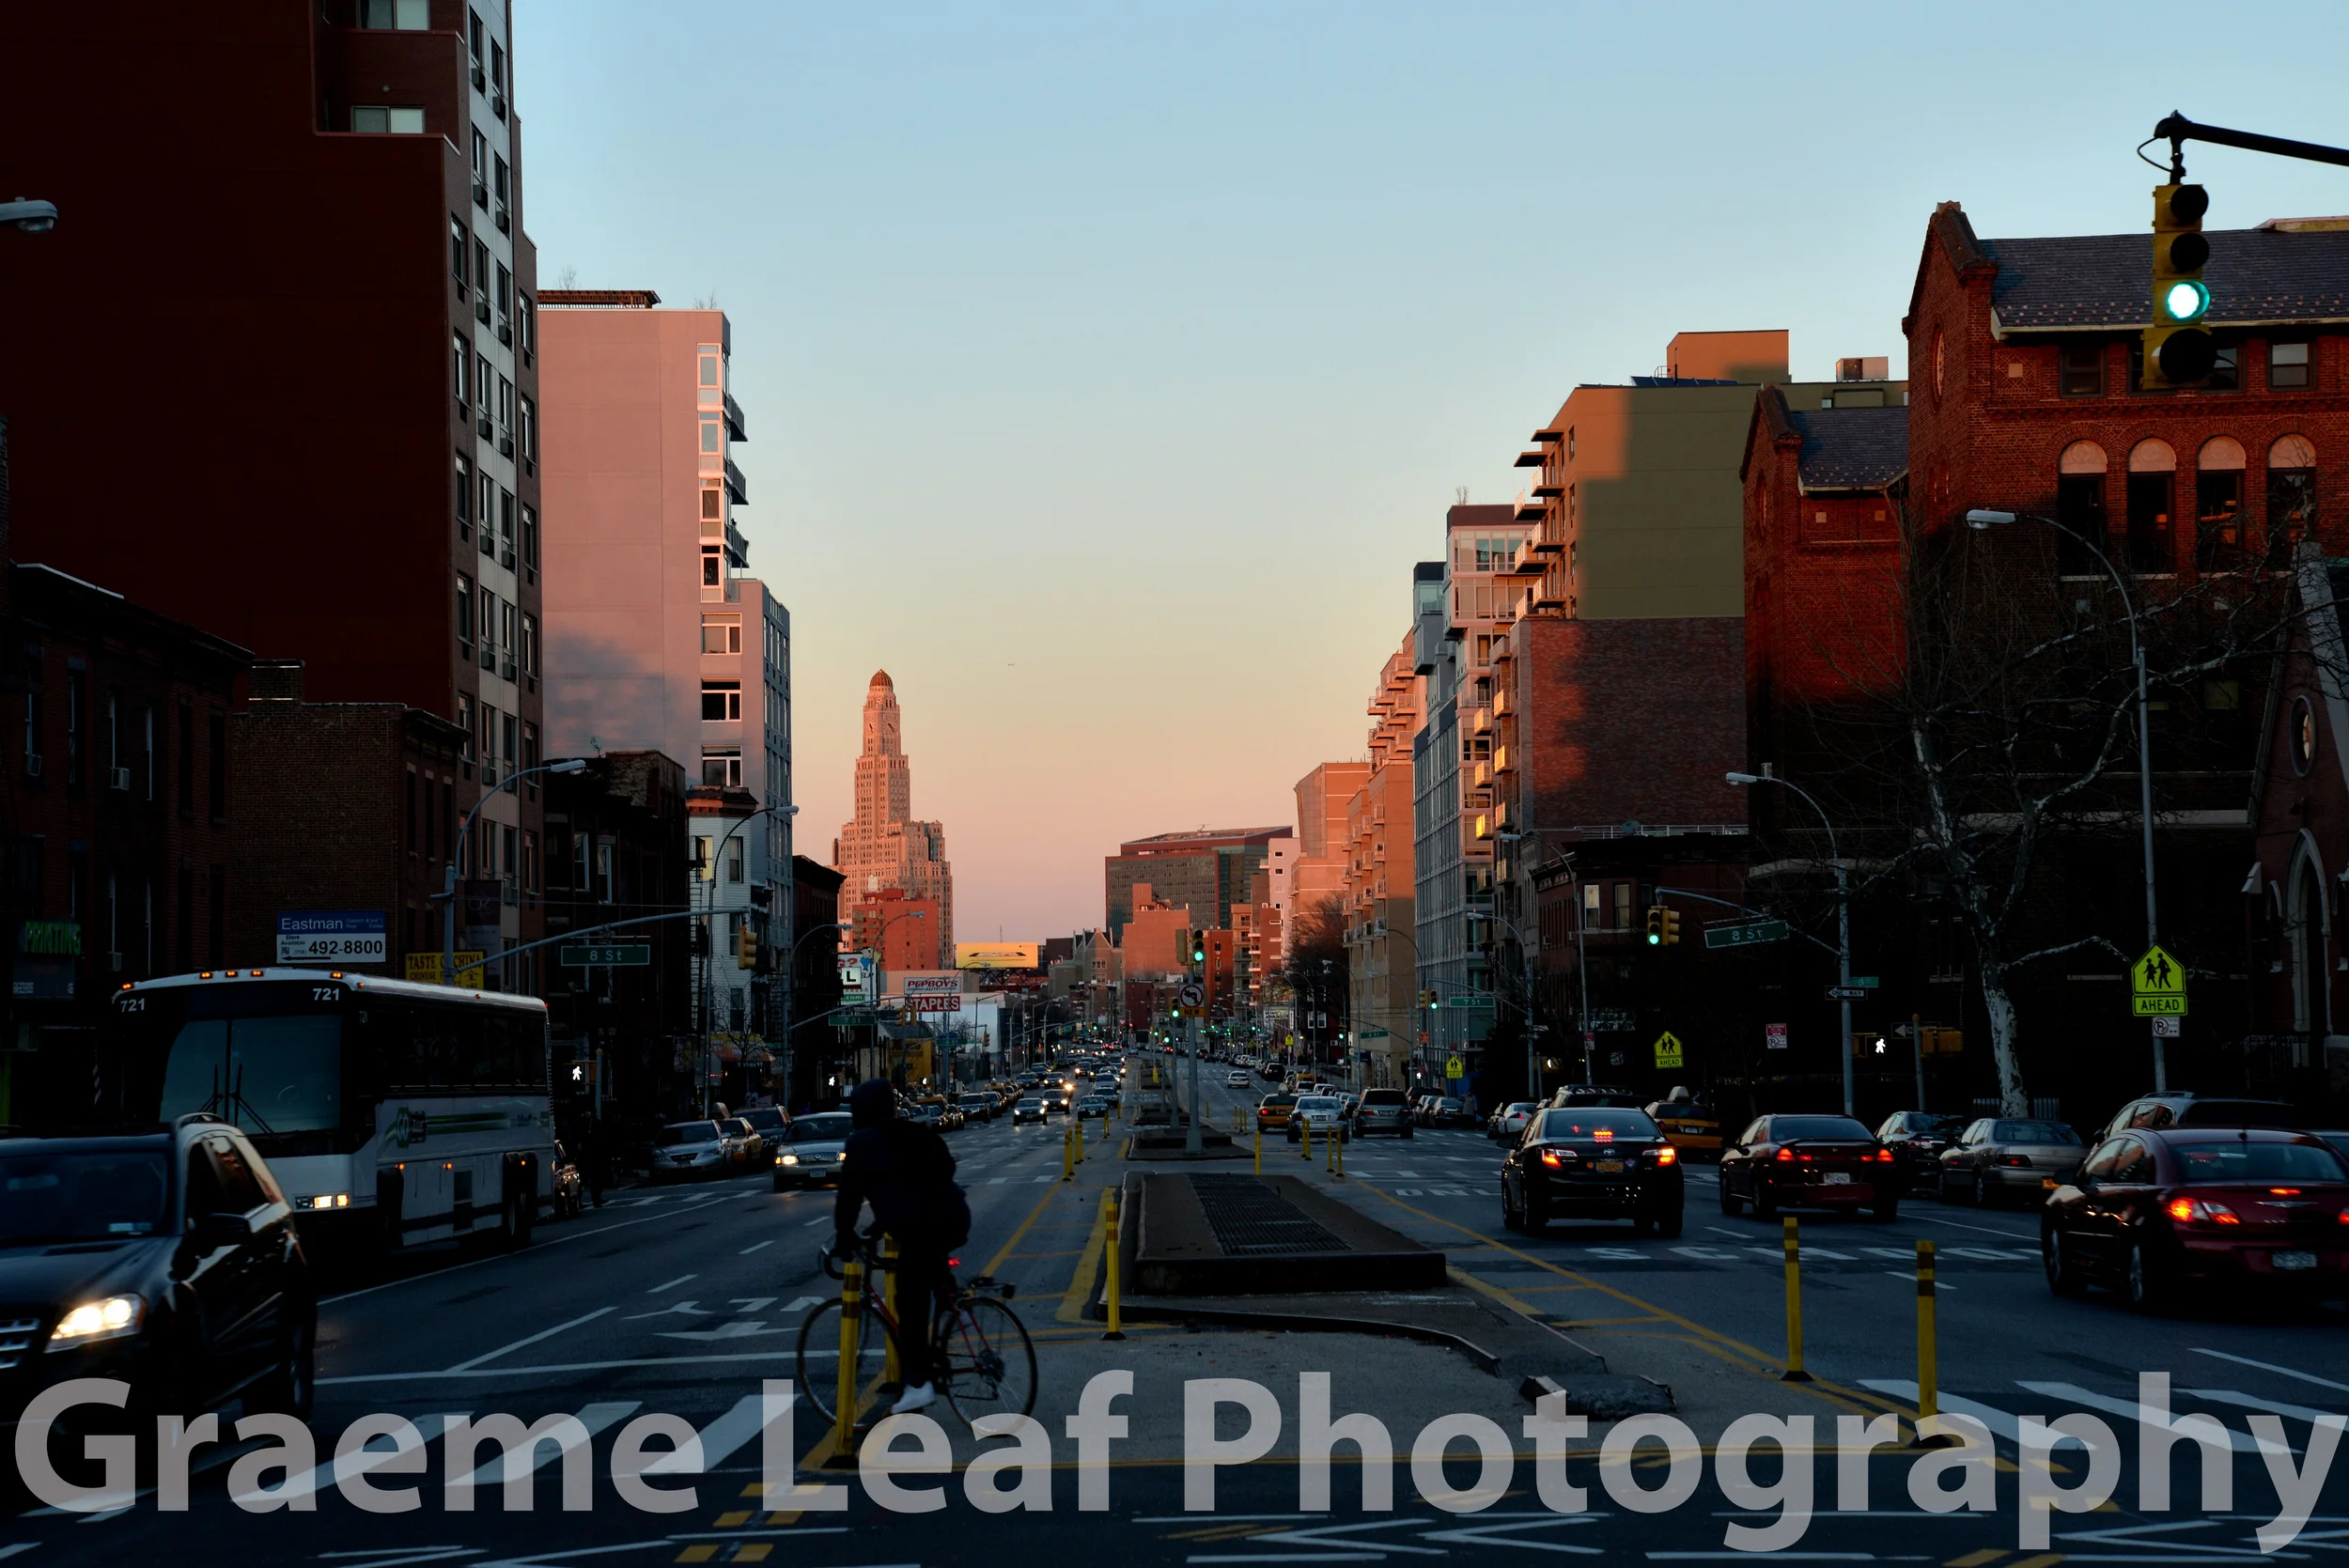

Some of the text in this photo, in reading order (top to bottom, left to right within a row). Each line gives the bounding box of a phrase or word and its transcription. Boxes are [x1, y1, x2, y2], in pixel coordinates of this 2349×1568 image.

[282, 918, 343, 930] Eastman
[24, 921, 82, 955] PRINTING
[1732, 928, 1764, 940] 8 St
[308, 940, 383, 955] 492-8800
[590, 950, 623, 961] 8 St
[408, 955, 437, 970] TASTE
[454, 955, 482, 969] CHINA
[847, 970, 857, 983] L
[313, 987, 340, 1001] 721
[119, 997, 147, 1012] 721
[906, 997, 959, 1012] STAPLES
[2141, 999, 2180, 1012] AHEAD
[1659, 1058, 1680, 1066] AHEAD
